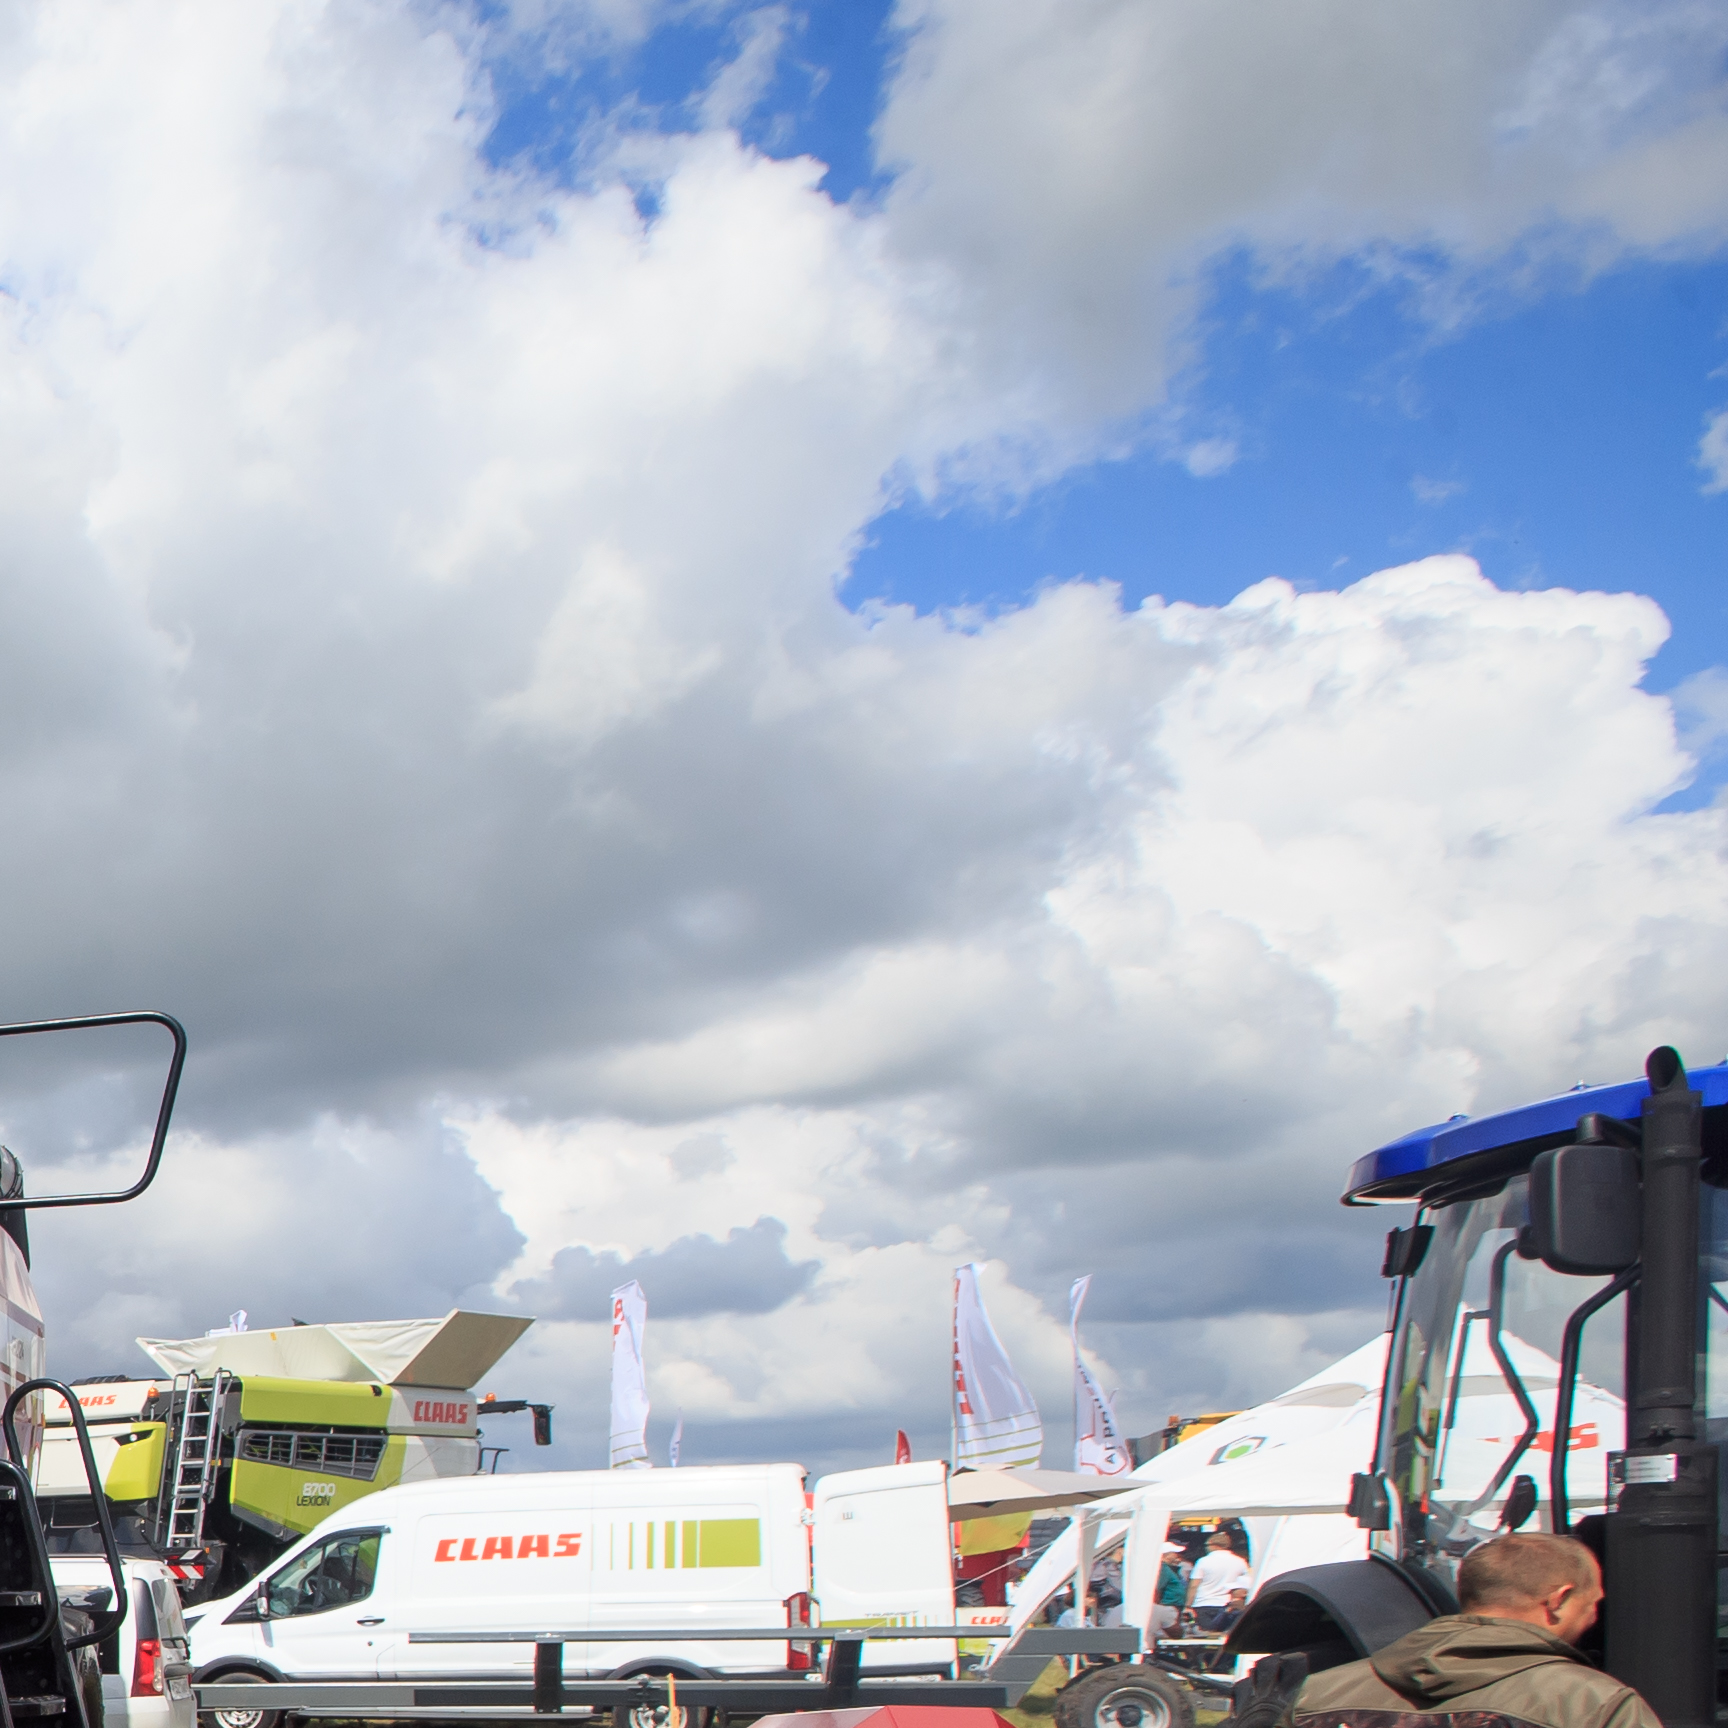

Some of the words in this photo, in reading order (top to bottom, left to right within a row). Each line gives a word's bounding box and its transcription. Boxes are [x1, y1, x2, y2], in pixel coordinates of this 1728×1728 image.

[58, 1395, 117, 1409] CAAS
[413, 1401, 468, 1424] CLAAS
[302, 1483, 336, 1496] 8700
[296, 1496, 331, 1506] LEXION
[434, 1532, 583, 1563] CLAAS
